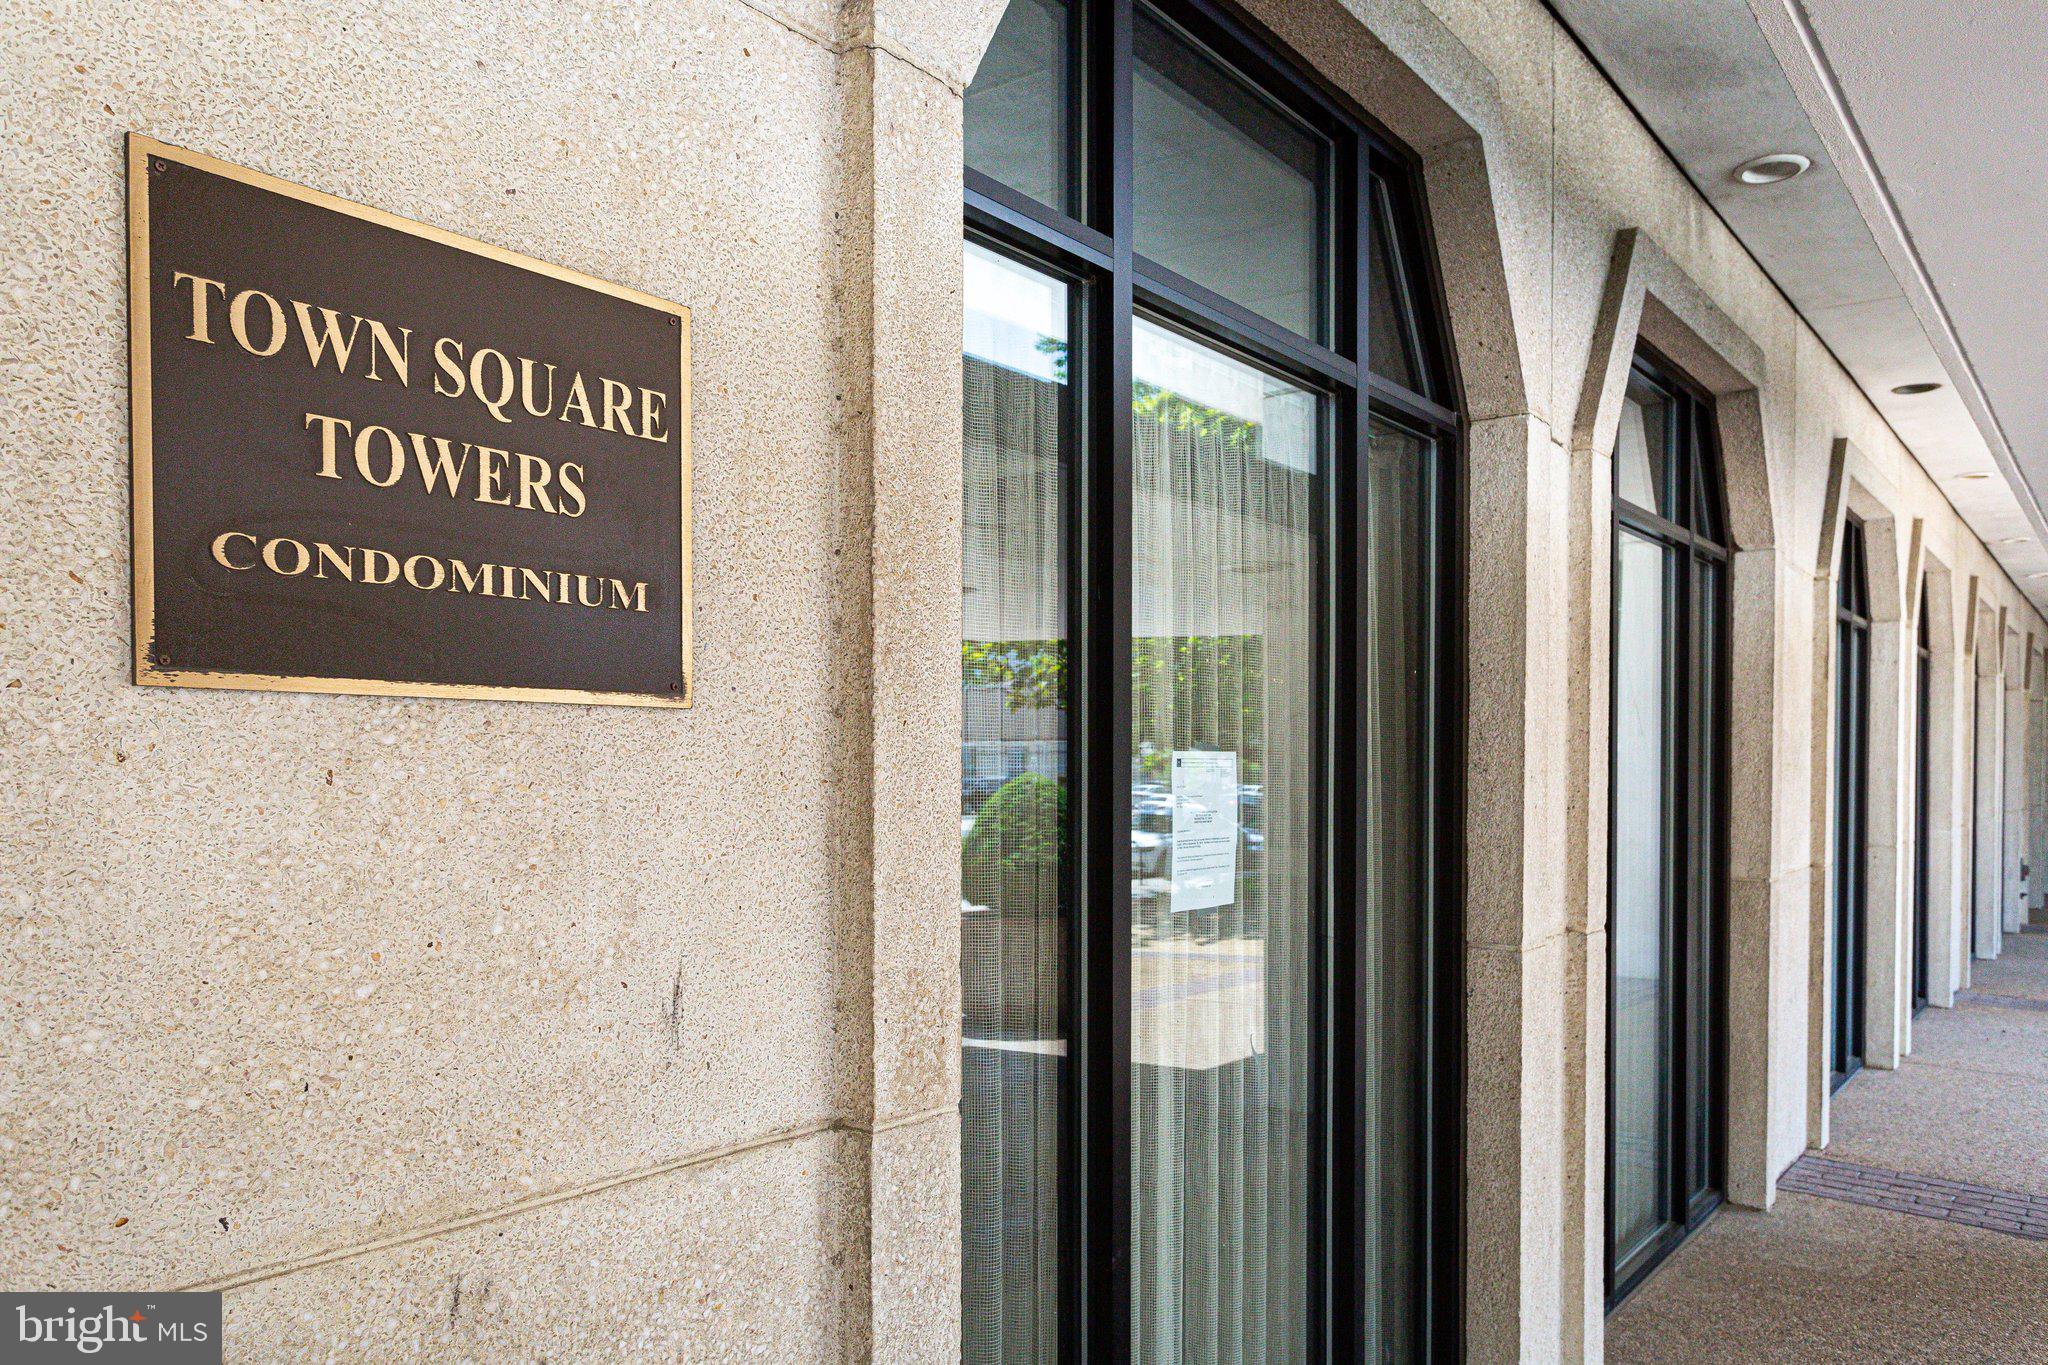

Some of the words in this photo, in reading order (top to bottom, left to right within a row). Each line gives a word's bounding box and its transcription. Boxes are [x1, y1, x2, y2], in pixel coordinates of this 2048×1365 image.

[173, 270, 412, 387] TOWN
[434, 337, 669, 443] SQUARE
[305, 413, 586, 518] TOWERS
[211, 531, 649, 612] CONDOMINIUM
